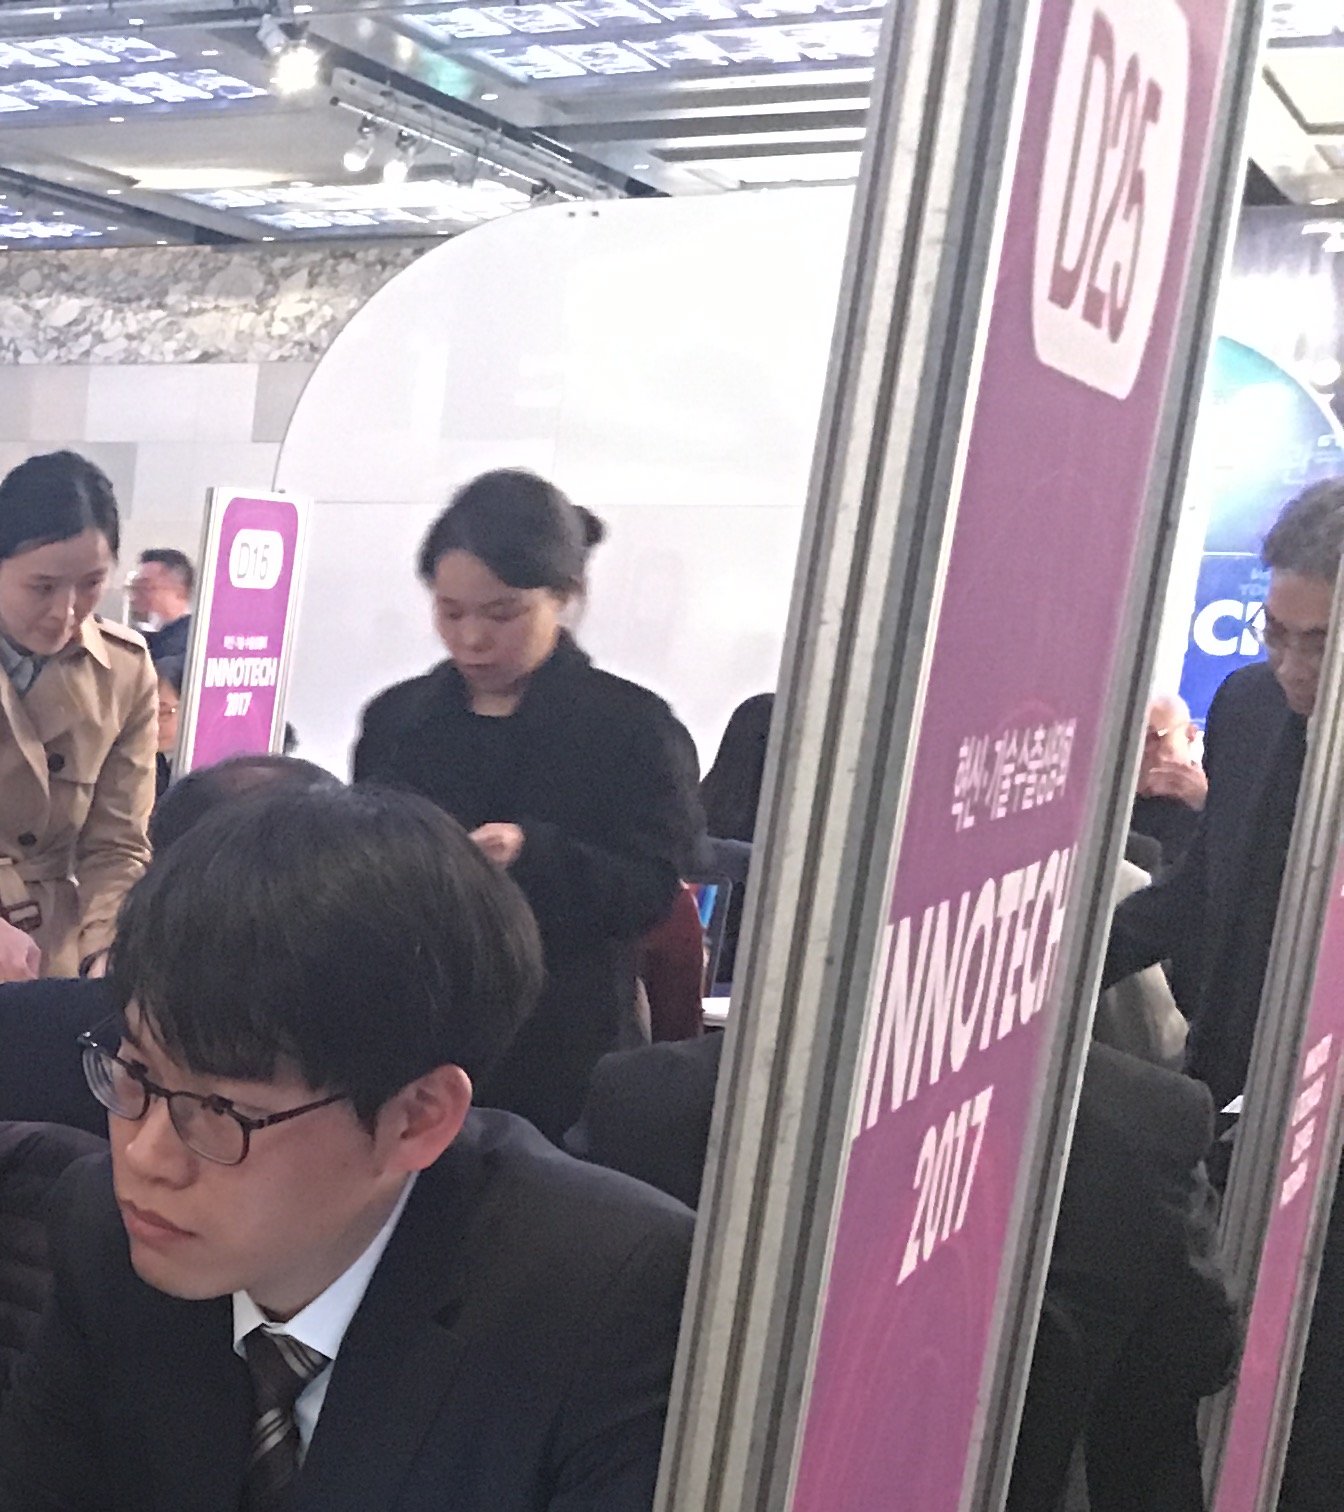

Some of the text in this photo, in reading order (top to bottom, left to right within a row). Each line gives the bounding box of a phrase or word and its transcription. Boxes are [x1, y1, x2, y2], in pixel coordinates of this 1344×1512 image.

[1048, 7, 1163, 344] D25
[237, 542, 270, 581] D15
[205, 657, 278, 688] INNOTECH
[852, 842, 1079, 1140] INNOTECH
[897, 1086, 994, 1287] 2017
